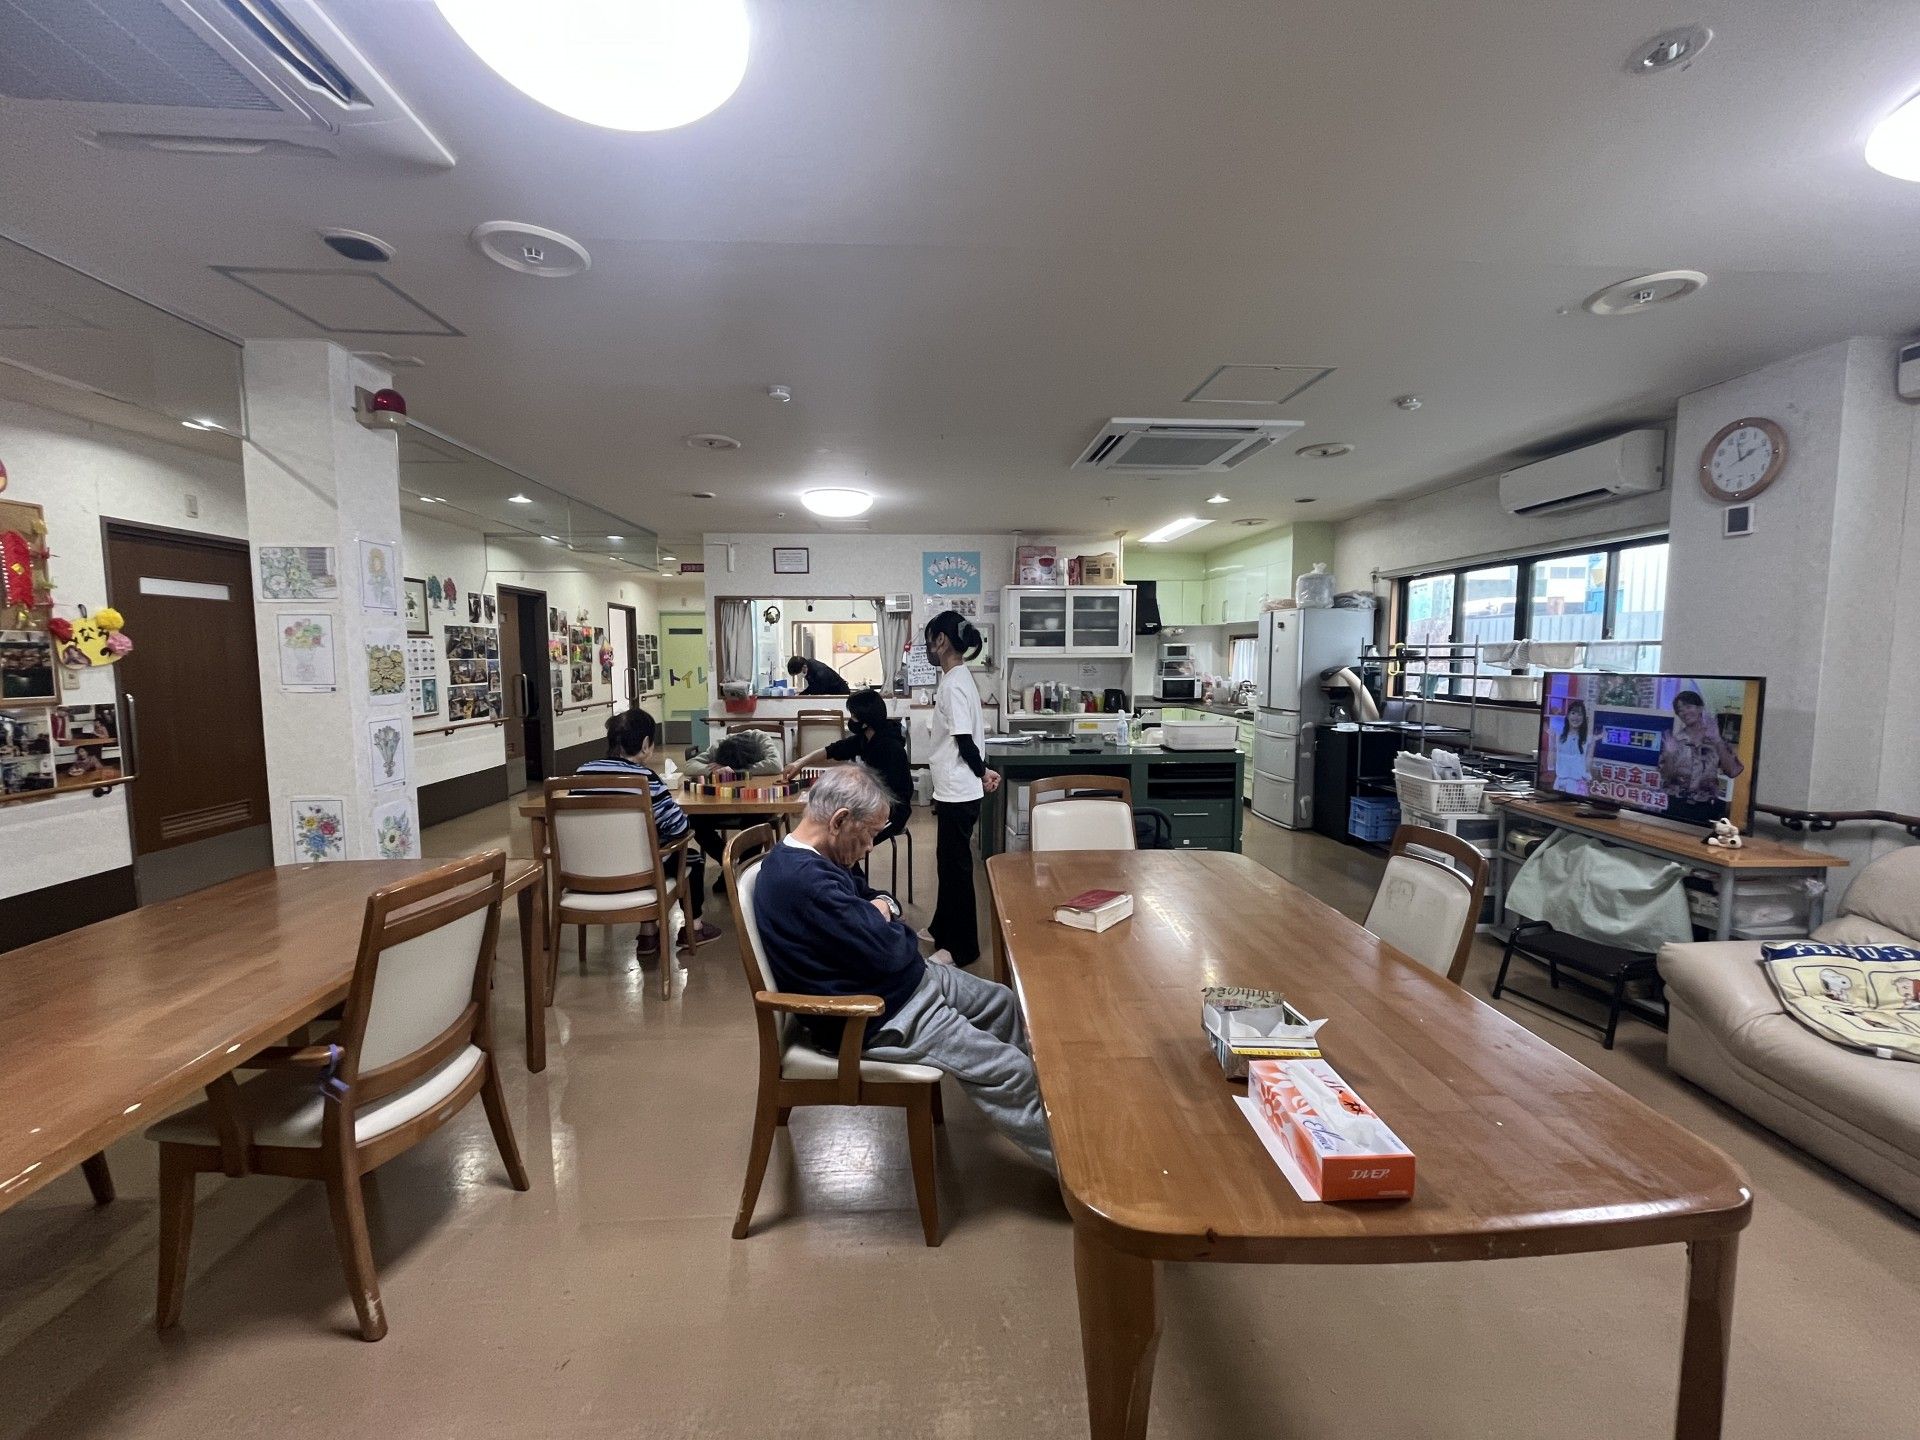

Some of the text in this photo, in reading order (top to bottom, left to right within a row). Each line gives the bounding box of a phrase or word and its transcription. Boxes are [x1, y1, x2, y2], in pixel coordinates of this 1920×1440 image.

[669, 667, 707, 688] トイレ
[1601, 764, 1660, 788] 毎週金曜
[1591, 780, 1668, 808] よる10時放送
[1348, 1168, 1391, 1180] エルモア
